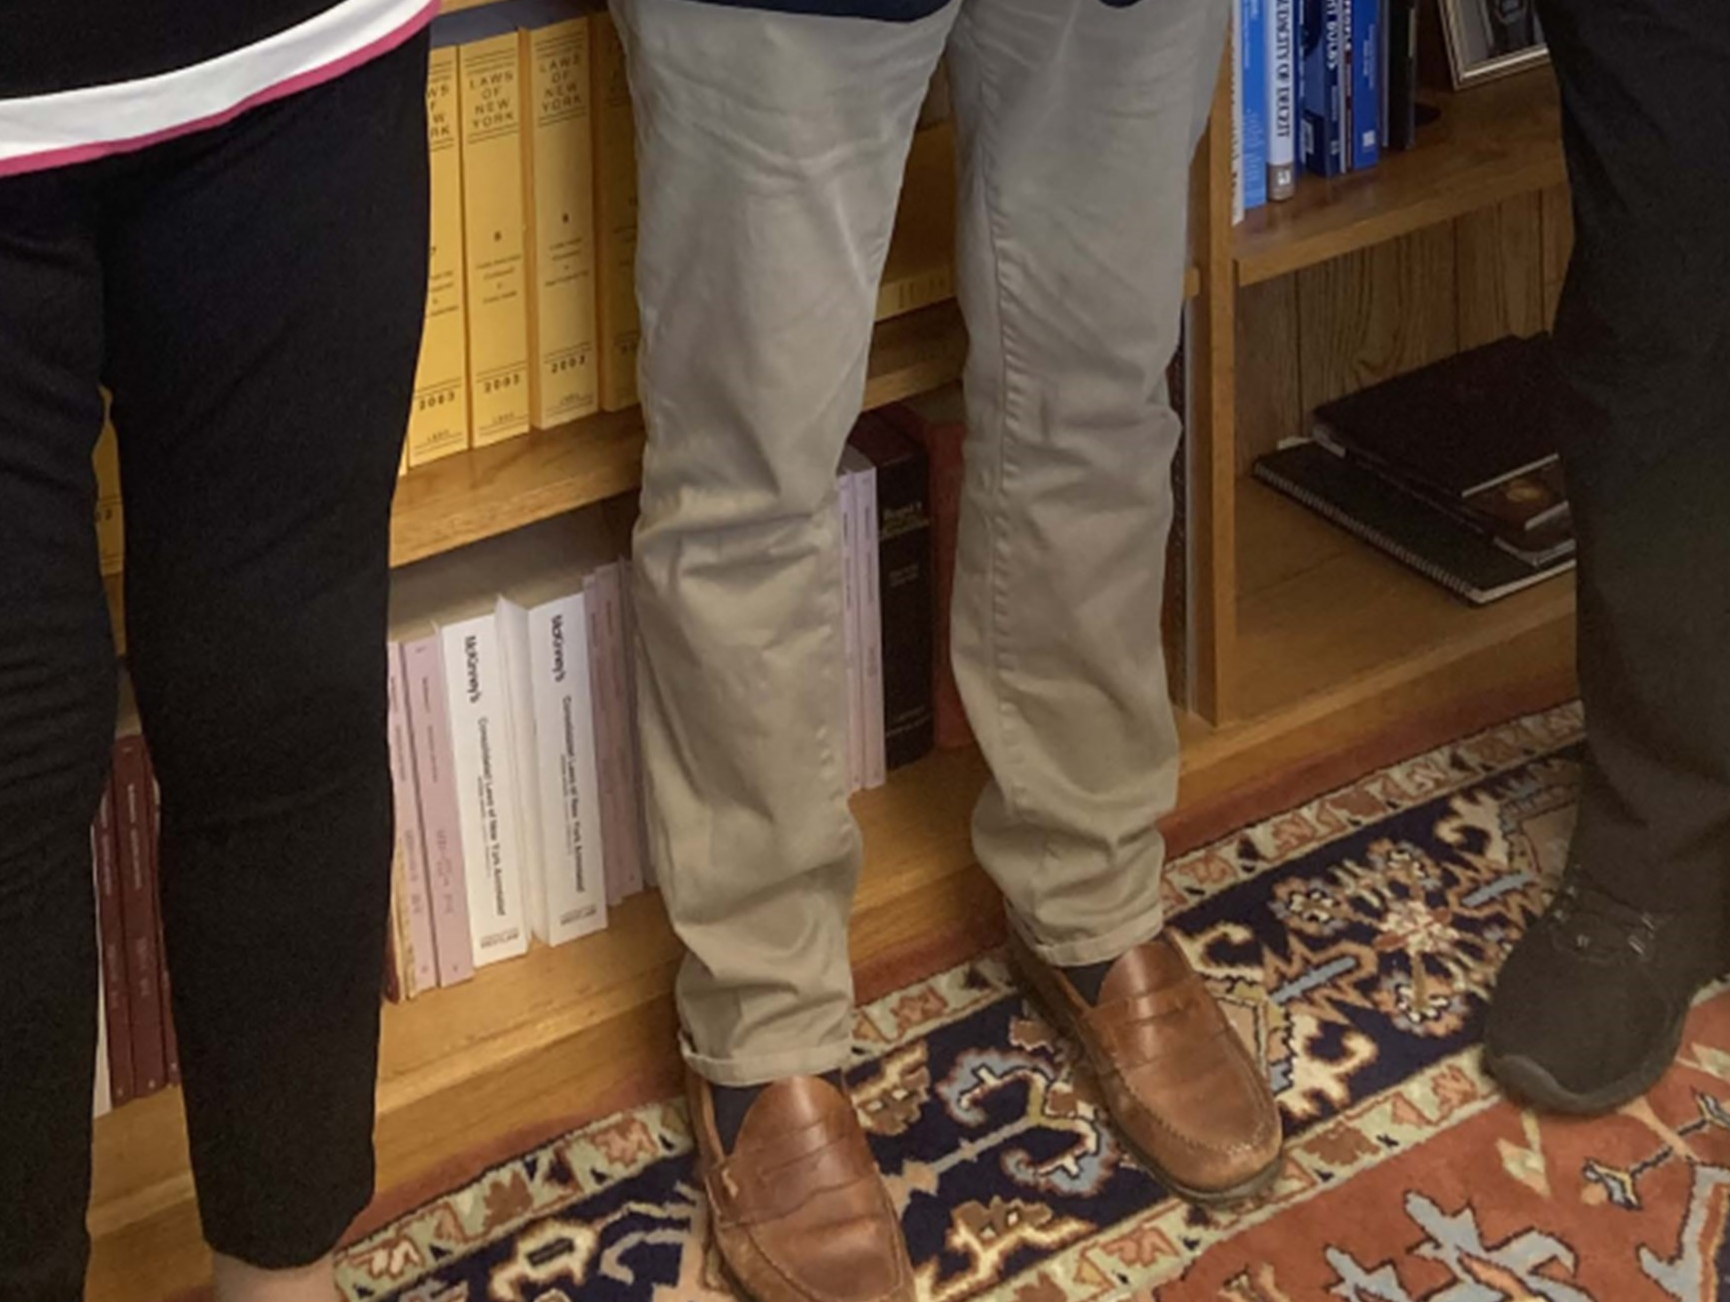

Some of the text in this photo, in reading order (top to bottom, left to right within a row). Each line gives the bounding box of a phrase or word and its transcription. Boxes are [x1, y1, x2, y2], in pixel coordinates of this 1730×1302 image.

[1344, 0, 1352, 52] PEOPLE
[1326, 21, 1339, 70] BULBS
[540, 53, 580, 74] LAWS
[1276, 63, 1290, 80] OF
[470, 71, 514, 90] LAWS
[552, 70, 570, 84] OF
[482, 87, 501, 100] OF
[545, 82, 578, 98] NEW
[474, 98, 510, 115] NEW
[541, 95, 582, 113] YORK
[1276, 87, 1290, 137] DECEIT
[472, 112, 514, 129] YORK
[484, 373, 520, 394] 2003
[419, 391, 456, 411] 2003
[551, 614, 566, 683] McKinney's
[465, 636, 481, 704] McKinney's
[562, 696, 575, 757] Consolidated
[478, 716, 492, 779] Consolidated
[568, 759, 576, 785] Laws
[485, 781, 494, 806] Laws
[488, 808, 497, 818] of
[573, 821, 581, 844] York
[491, 843, 500, 866] York
[575, 846, 585, 893] Annotated
[495, 868, 506, 916] Annotated
